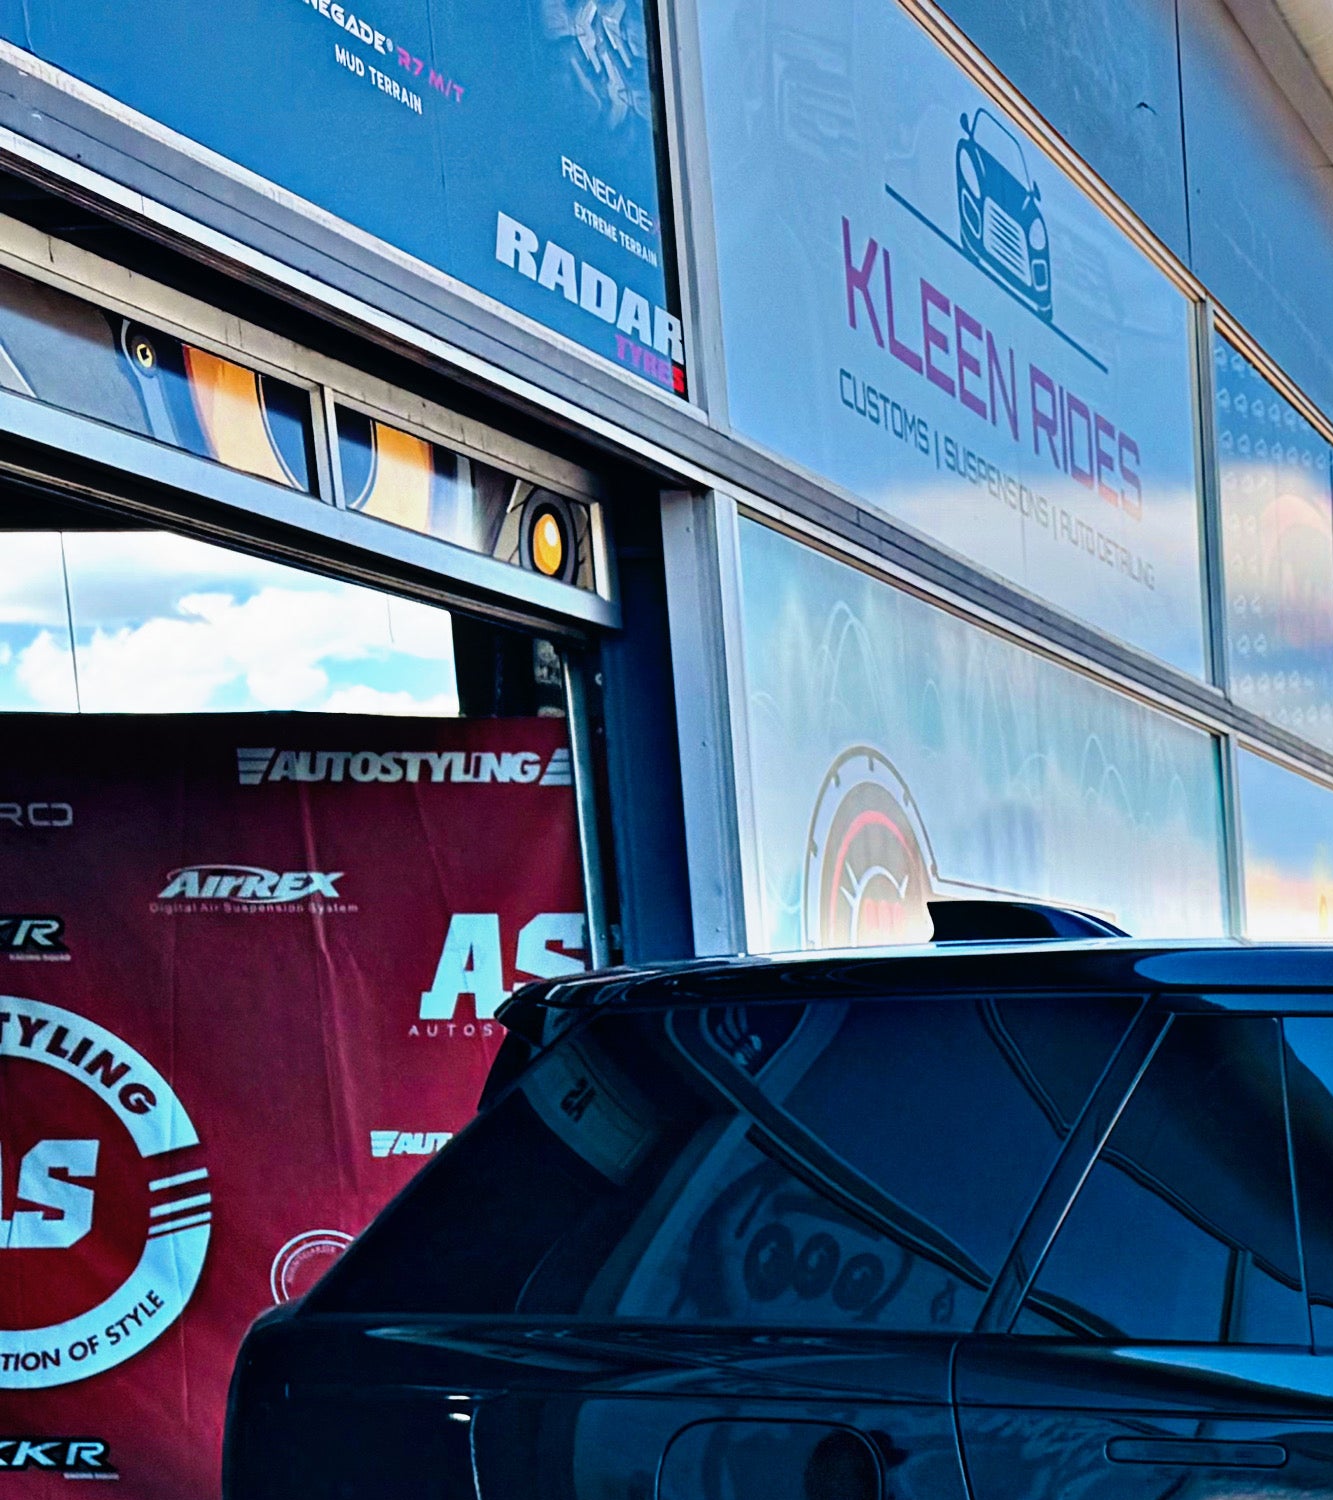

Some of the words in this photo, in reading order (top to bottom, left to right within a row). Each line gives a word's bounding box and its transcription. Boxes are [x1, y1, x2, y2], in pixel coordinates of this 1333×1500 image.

[335, 43, 365, 77] MUD
[368, 65, 423, 115] TERRAIN
[574, 201, 618, 242] EXTREME
[619, 230, 658, 268] TERRAIN
[496, 210, 685, 365] RADAR
[615, 334, 685, 394] TYRES
[842, 214, 1020, 442] KLEEN
[1029, 362, 1142, 522] RIDES
[839, 367, 930, 455] CUSTOMS
[267, 750, 541, 783] AUTOSTYLING
[408, 1024, 507, 1037] AUTOS
[68, 1335, 100, 1361] OF
[105, 1289, 165, 1346] STYLE
